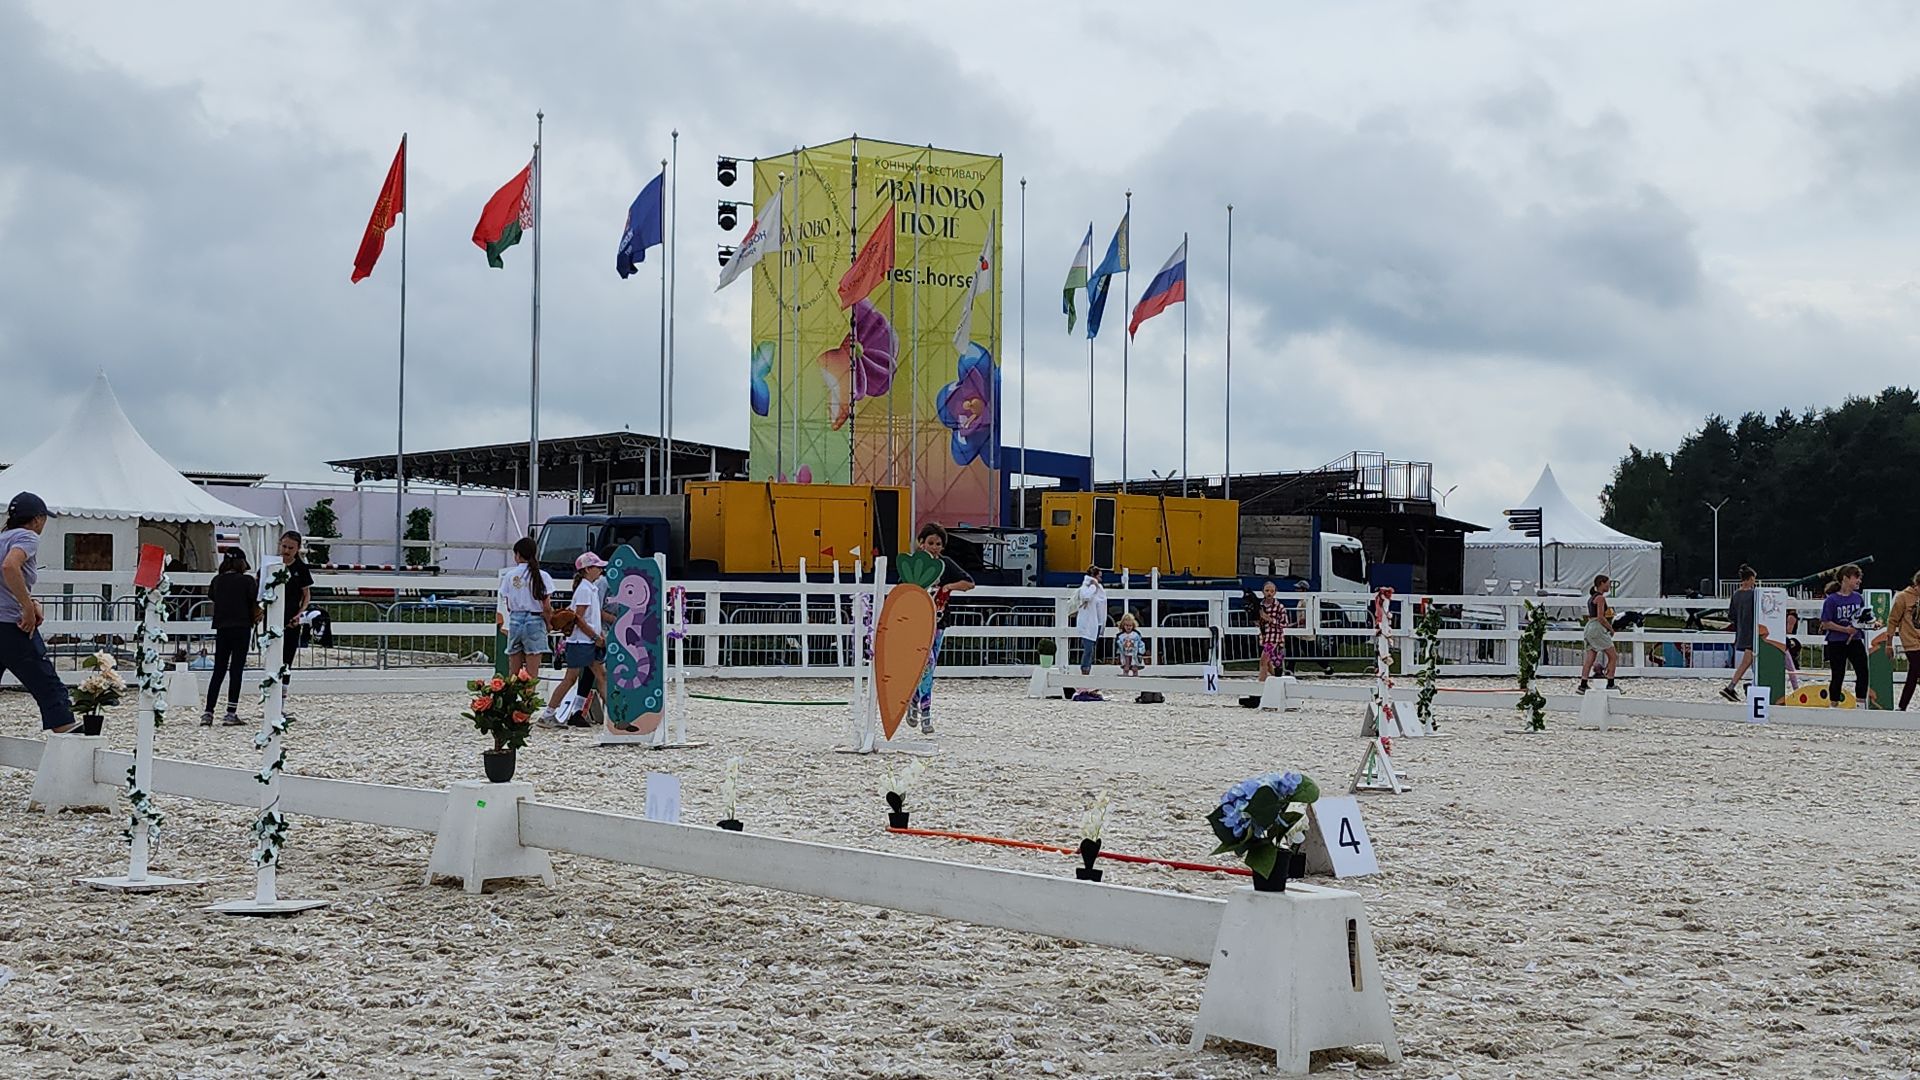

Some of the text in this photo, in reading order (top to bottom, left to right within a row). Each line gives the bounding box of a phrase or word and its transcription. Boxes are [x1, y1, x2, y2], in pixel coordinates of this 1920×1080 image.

[926, 165, 986, 181] ФЕСТИВАЛЬ
[876, 177, 985, 211] ИВАНОВО
[901, 212, 960, 239] ПОЛЕ
[1207, 673, 1217, 691] K
[1753, 696, 1766, 718] E
[1339, 817, 1361, 855] 4
